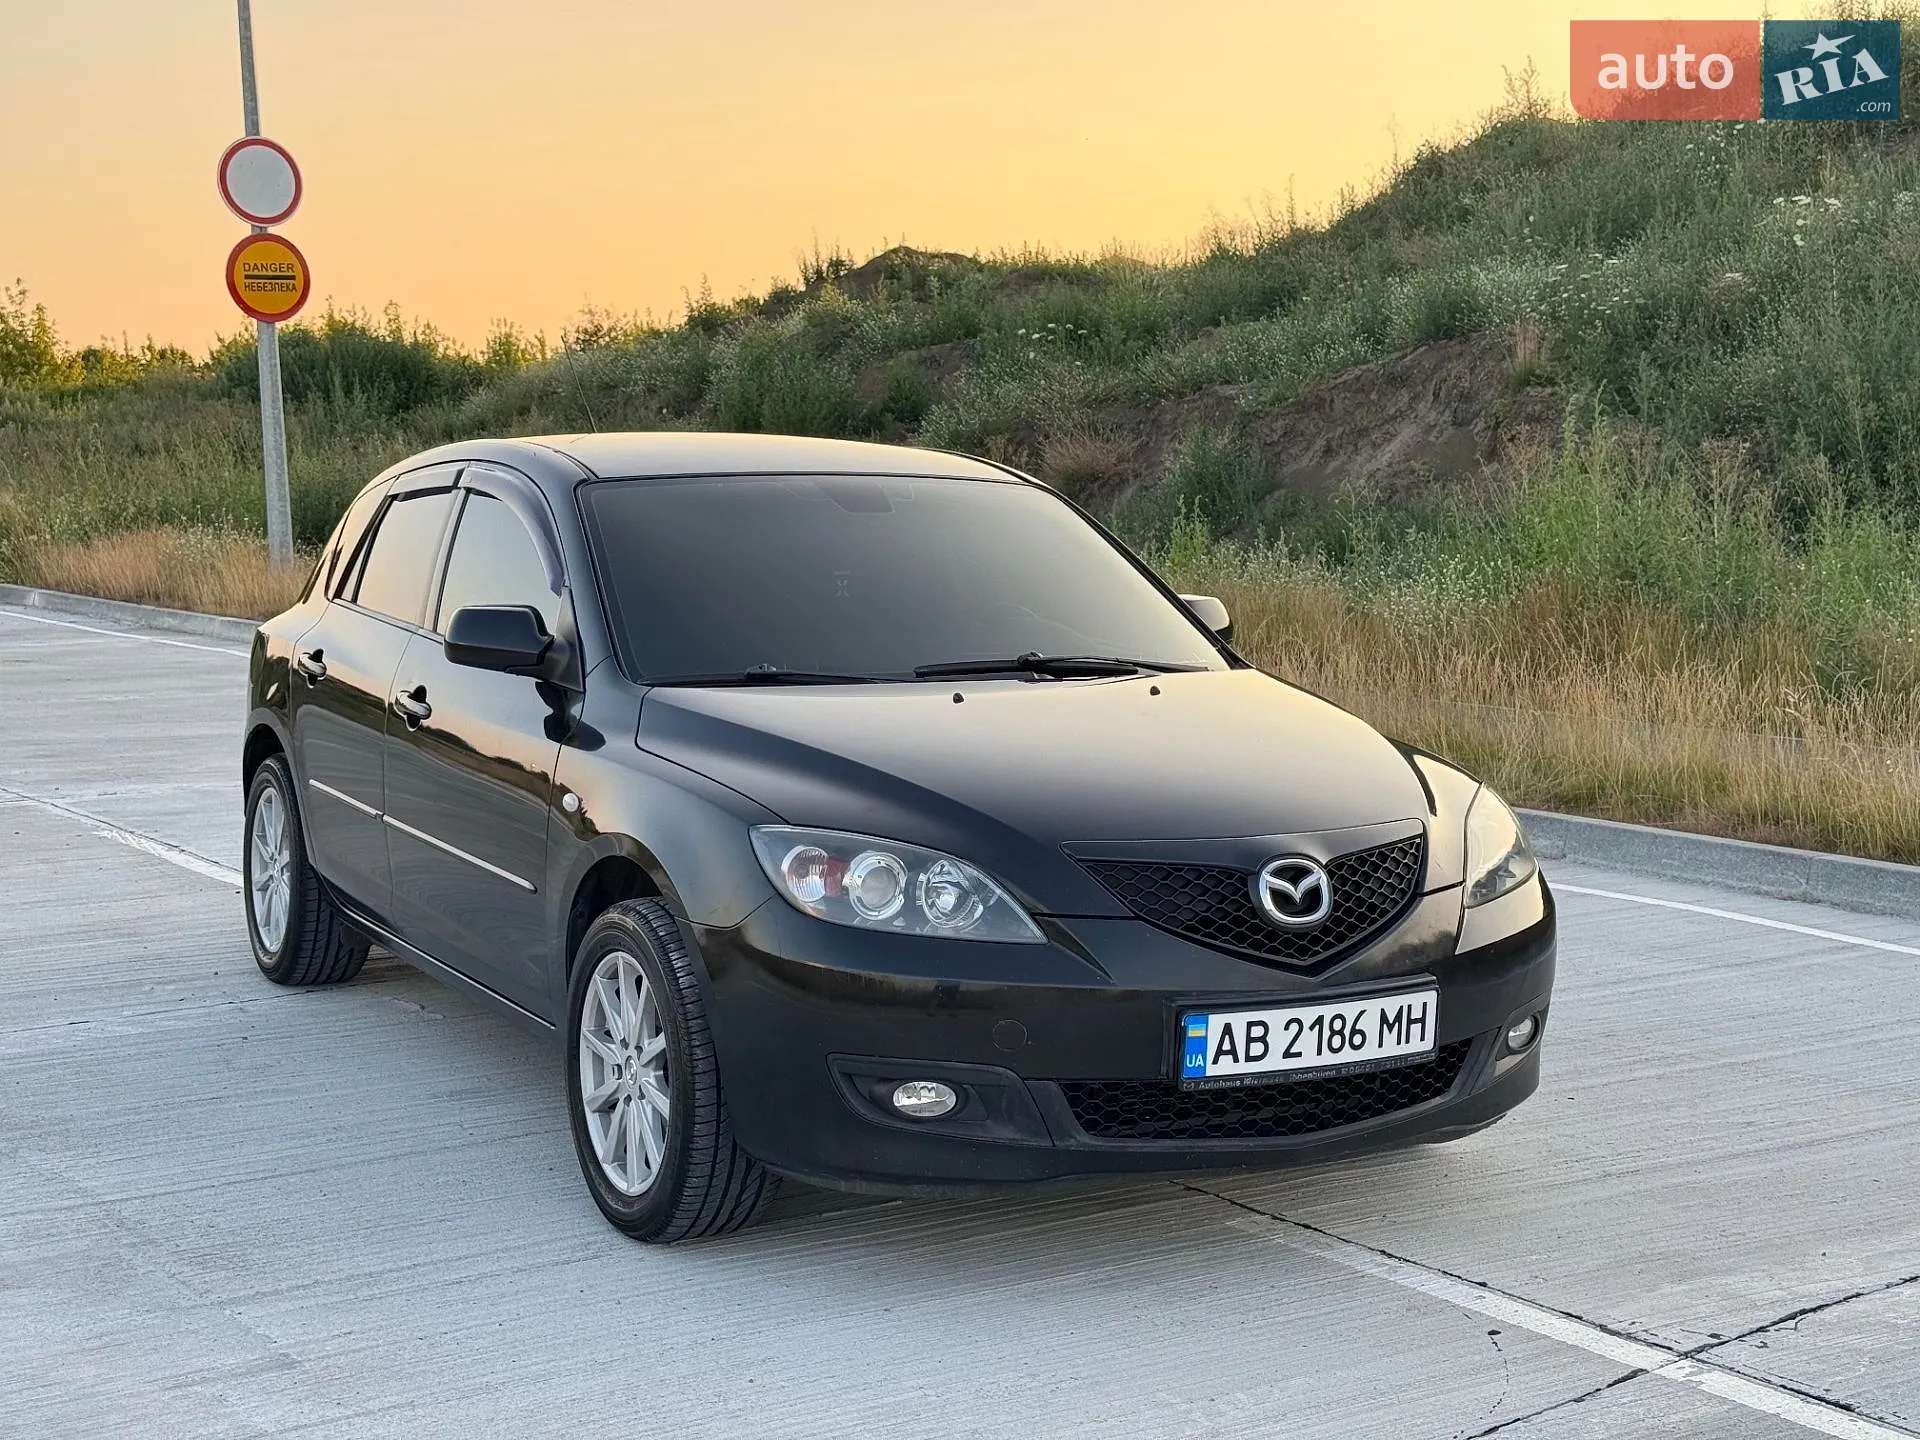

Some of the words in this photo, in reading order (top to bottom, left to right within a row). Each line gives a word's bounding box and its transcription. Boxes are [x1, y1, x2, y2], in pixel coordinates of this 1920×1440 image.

[243, 262, 295, 272] DANGER
[244, 281, 297, 292] НЕБЕЗПЕКА
[1211, 1019, 1270, 1066] AB
[1282, 1008, 1367, 1059] 2186
[1377, 1001, 1428, 1049] MH
[1186, 1054, 1204, 1068] UA
